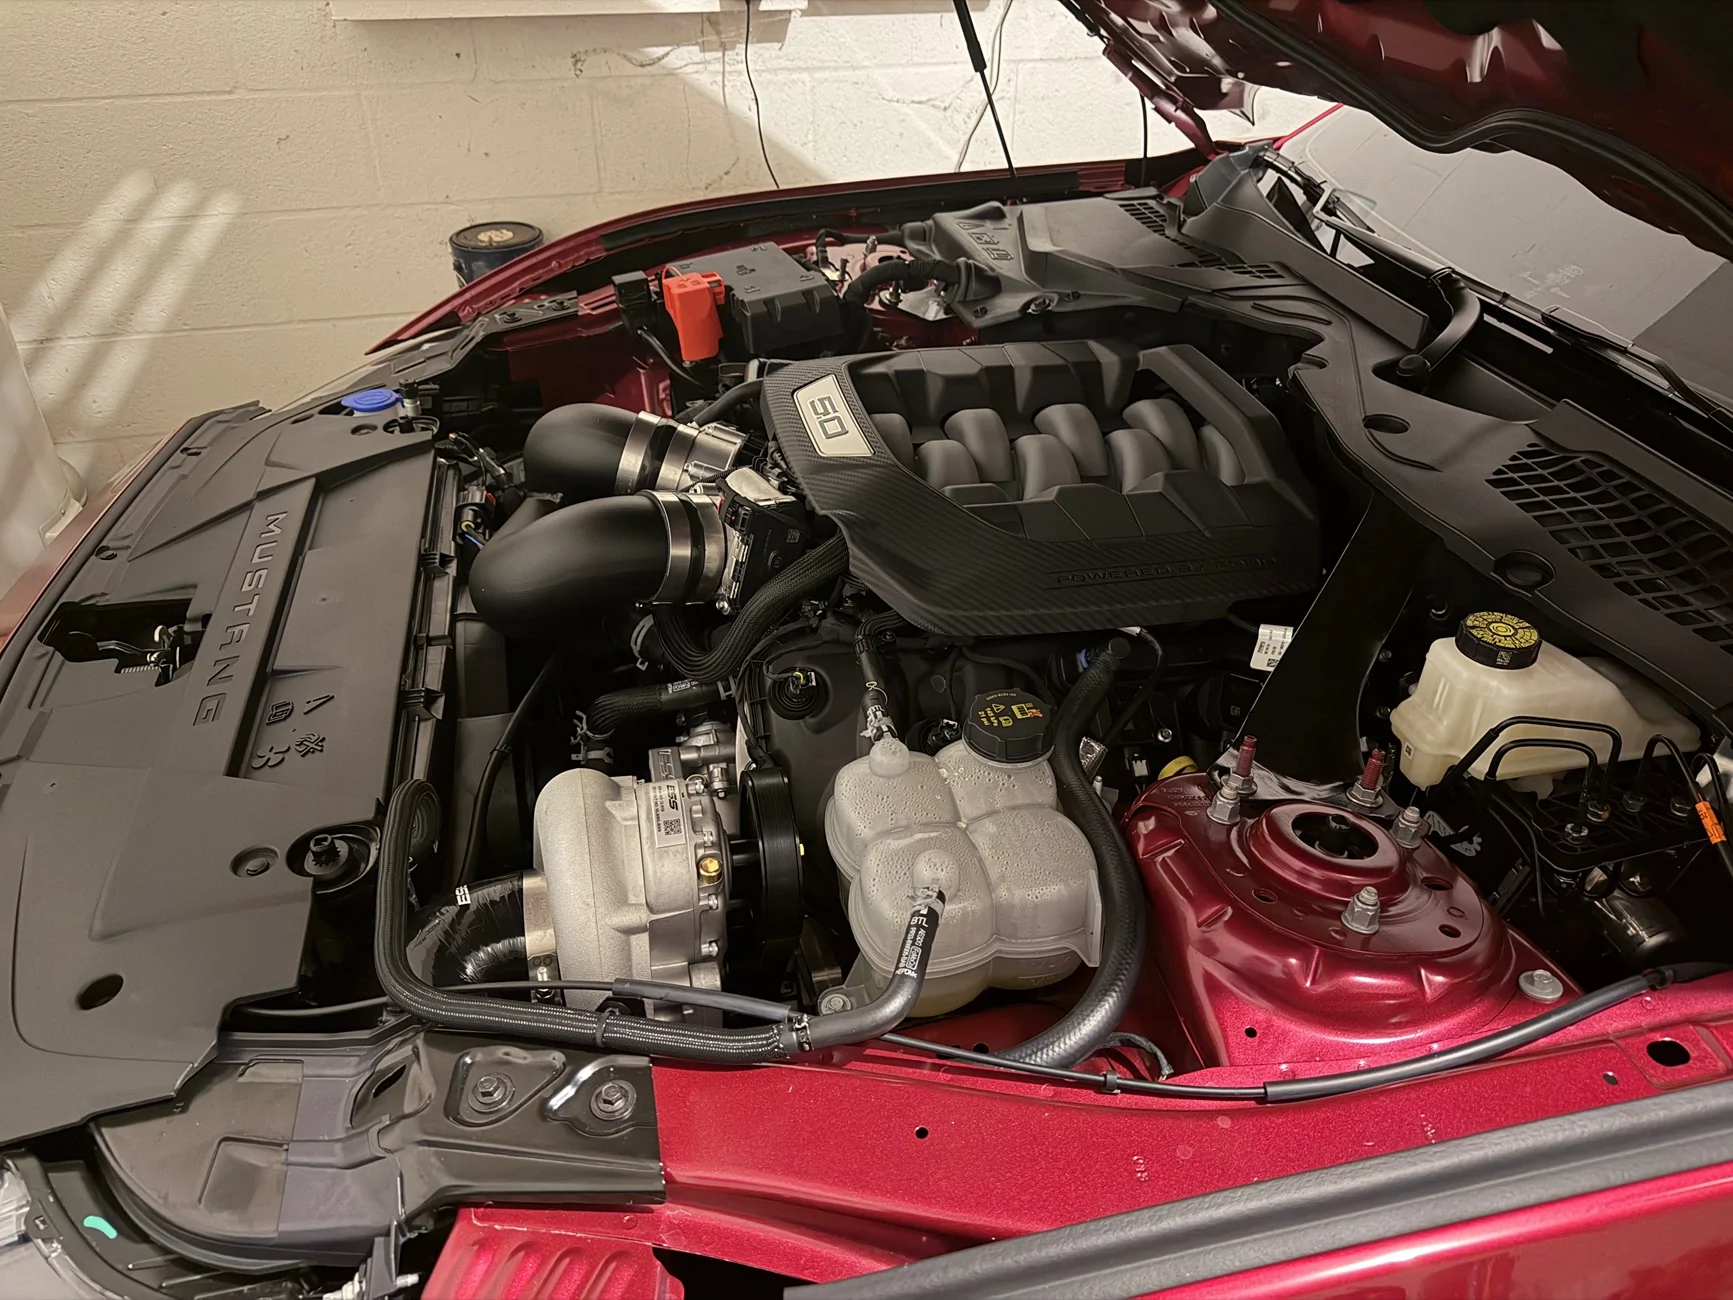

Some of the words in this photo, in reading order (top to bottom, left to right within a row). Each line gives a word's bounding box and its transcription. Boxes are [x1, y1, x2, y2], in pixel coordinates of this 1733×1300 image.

[808, 395, 849, 440] 5.0
[193, 511, 288, 726] MUSTANG
[666, 785, 679, 811] ESS
[910, 916, 929, 928] BTL
